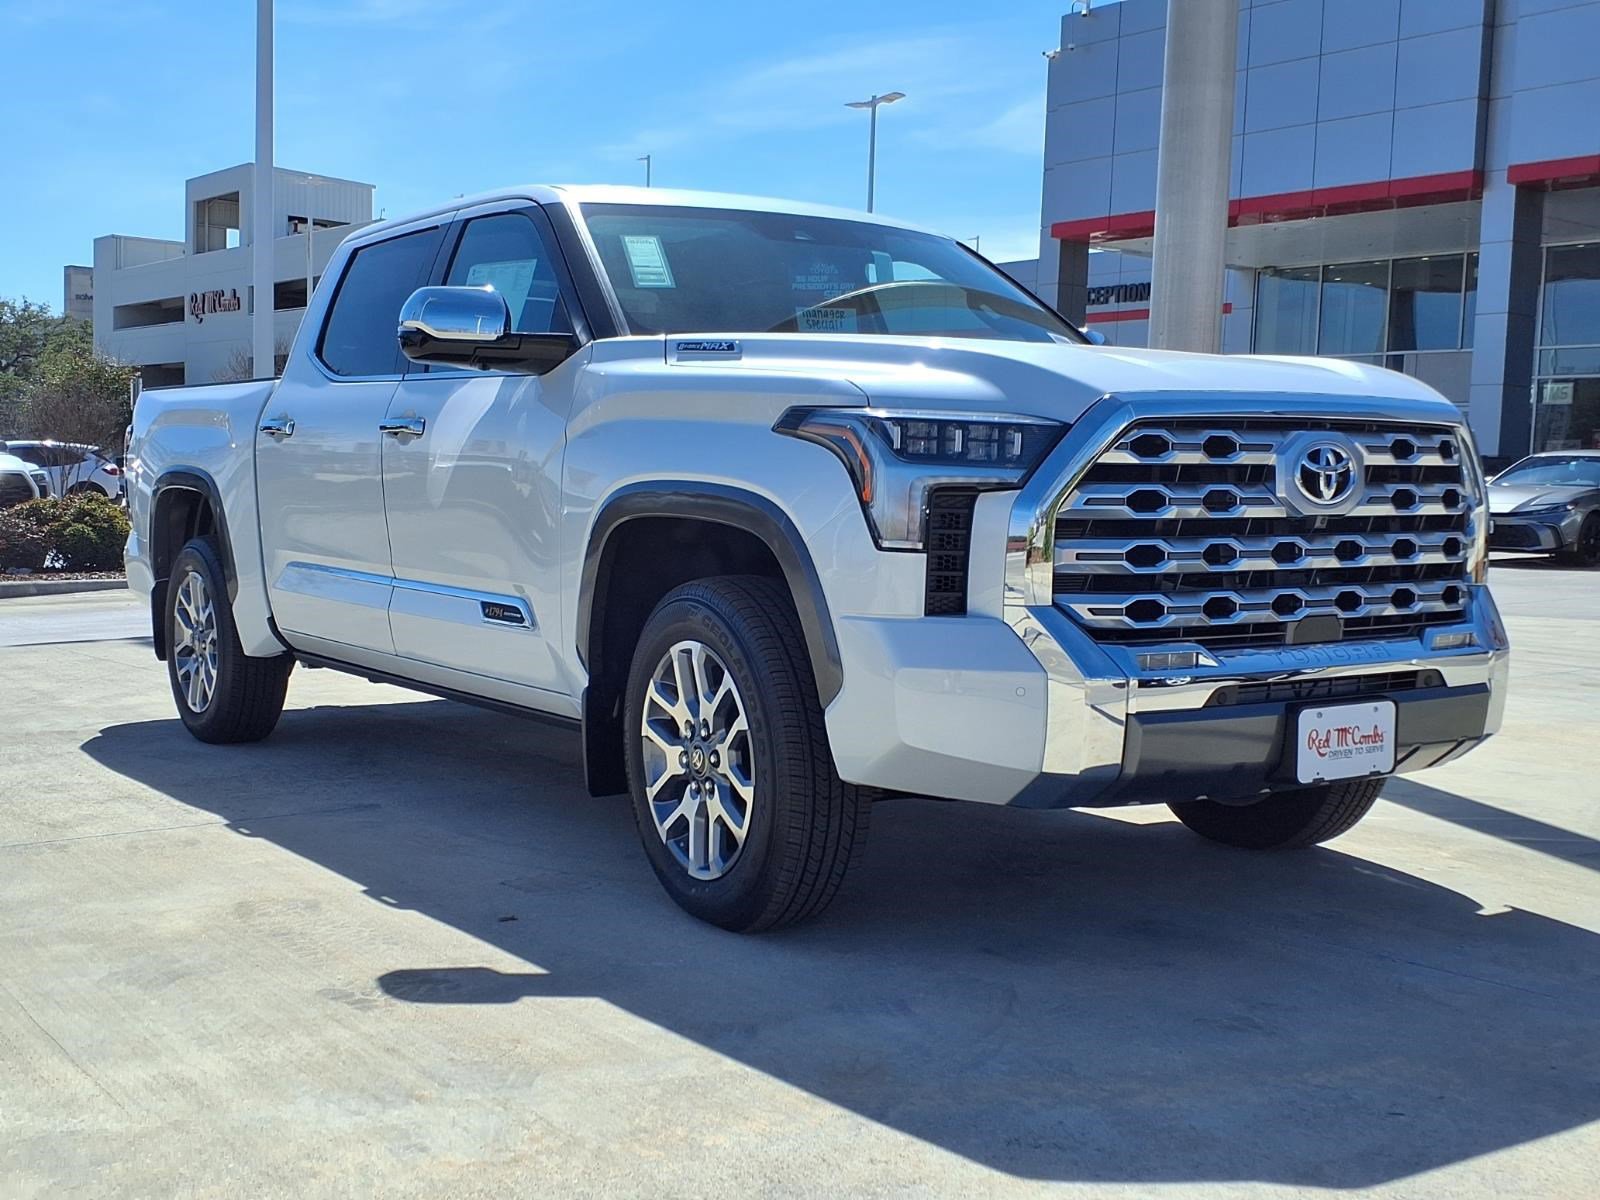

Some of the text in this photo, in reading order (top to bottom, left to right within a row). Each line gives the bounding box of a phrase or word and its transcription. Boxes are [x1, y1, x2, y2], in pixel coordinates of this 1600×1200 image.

[1271, 645, 1391, 665] TUNDRA
[1307, 728, 1331, 758] Red
[1328, 745, 1385, 758] DRIVEN TO SERVE
